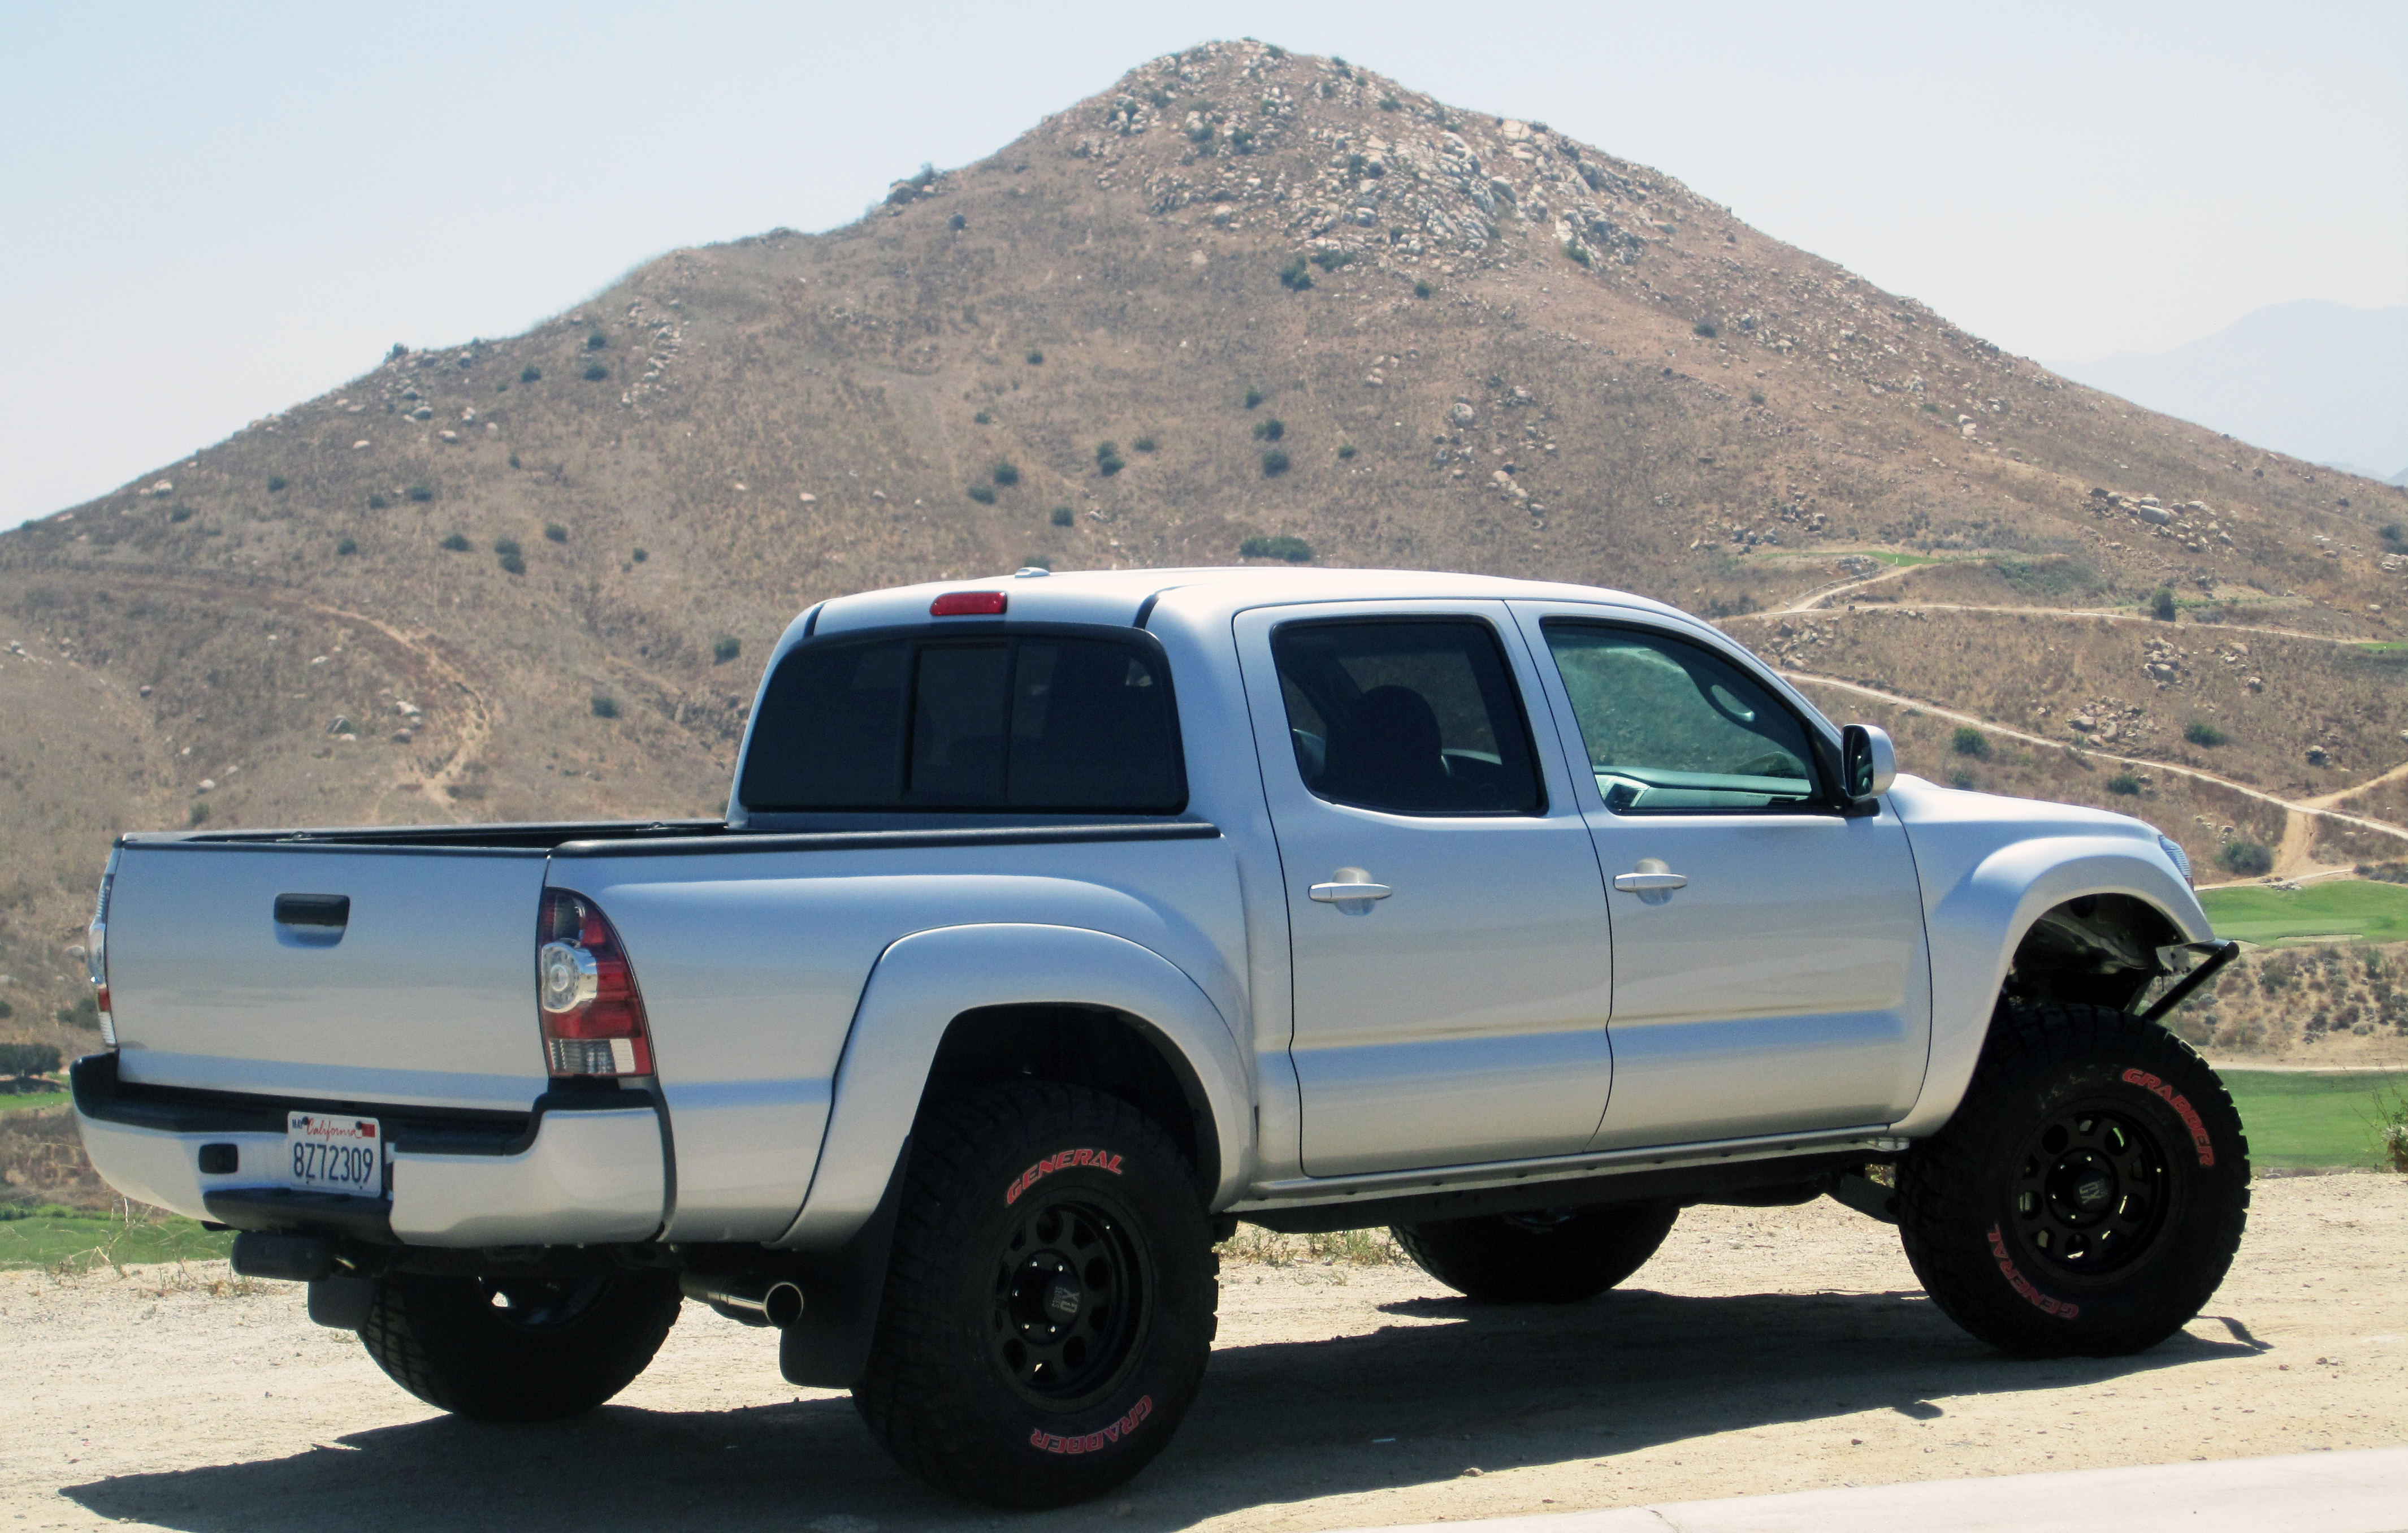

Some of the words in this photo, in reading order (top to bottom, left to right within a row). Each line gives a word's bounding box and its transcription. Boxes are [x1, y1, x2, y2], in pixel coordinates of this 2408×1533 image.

[307, 1118, 362, 1141] California
[2123, 1068, 2214, 1166] GRABBER
[294, 1142, 373, 1184] 8Z72309
[1006, 1149, 1122, 1205] GENERAL
[1988, 1223, 2079, 1318] GENERAL
[1030, 1395, 1152, 1454] GRABBER
